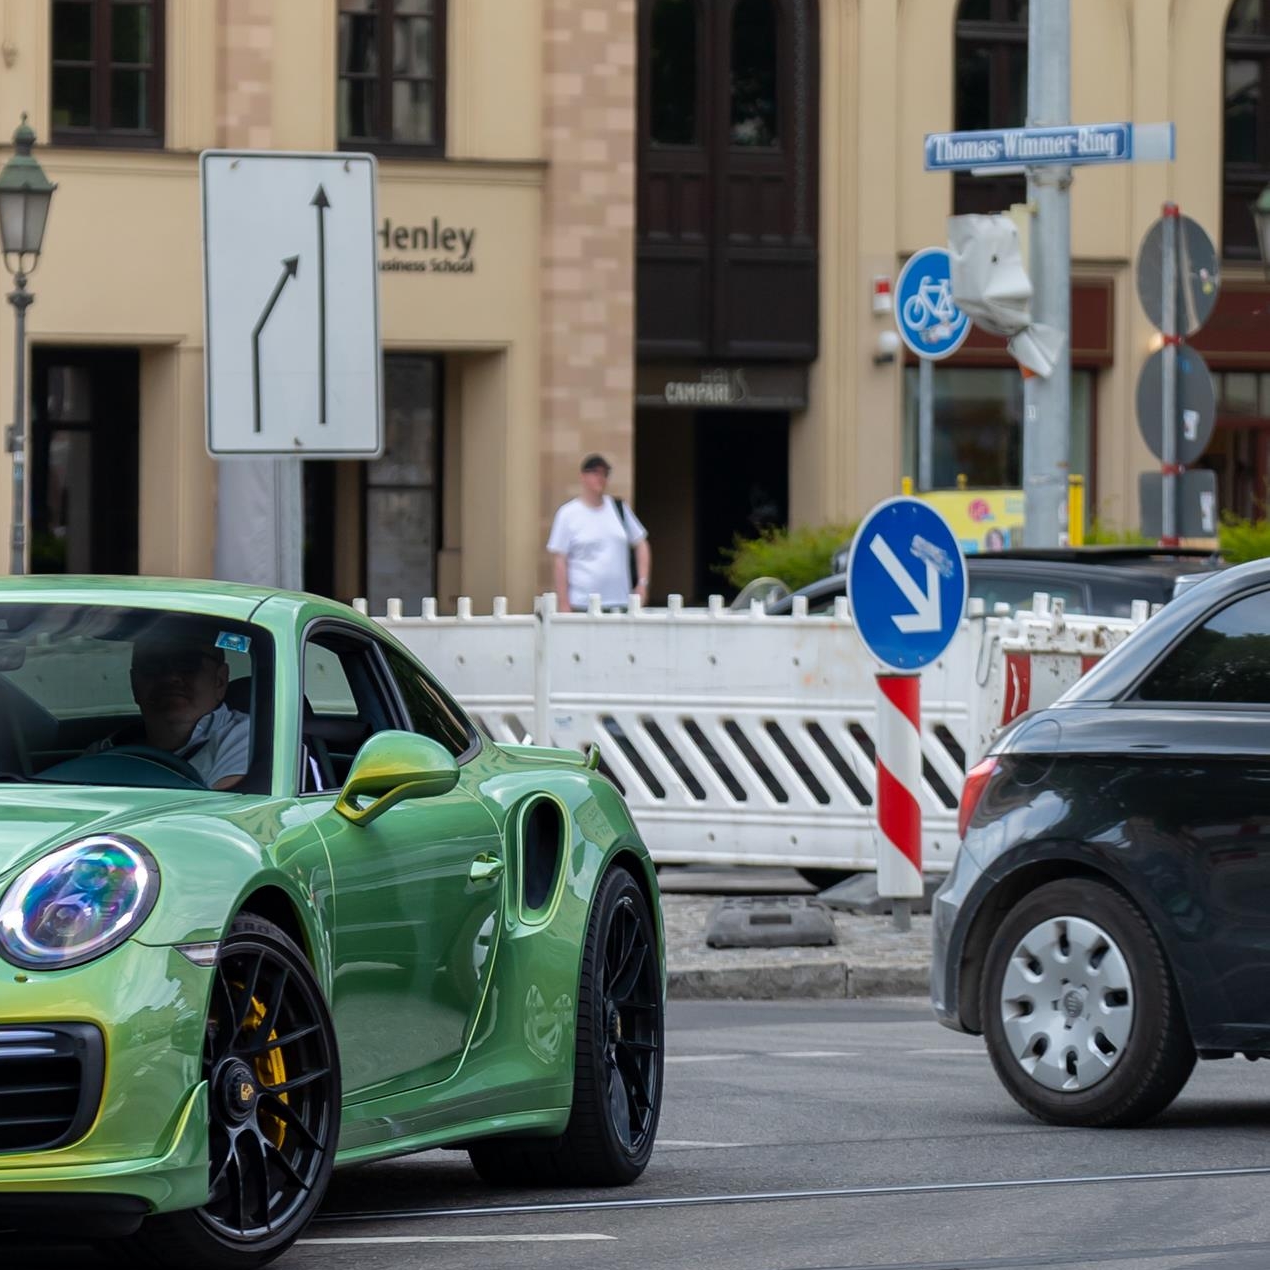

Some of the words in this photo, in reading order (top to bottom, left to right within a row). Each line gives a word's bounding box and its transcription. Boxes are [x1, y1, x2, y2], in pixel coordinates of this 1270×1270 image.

[934, 126, 1118, 162] Thomas-Wimmer-Ring
[430, 258, 474, 272] School
[665, 381, 730, 404] CAMPARI
